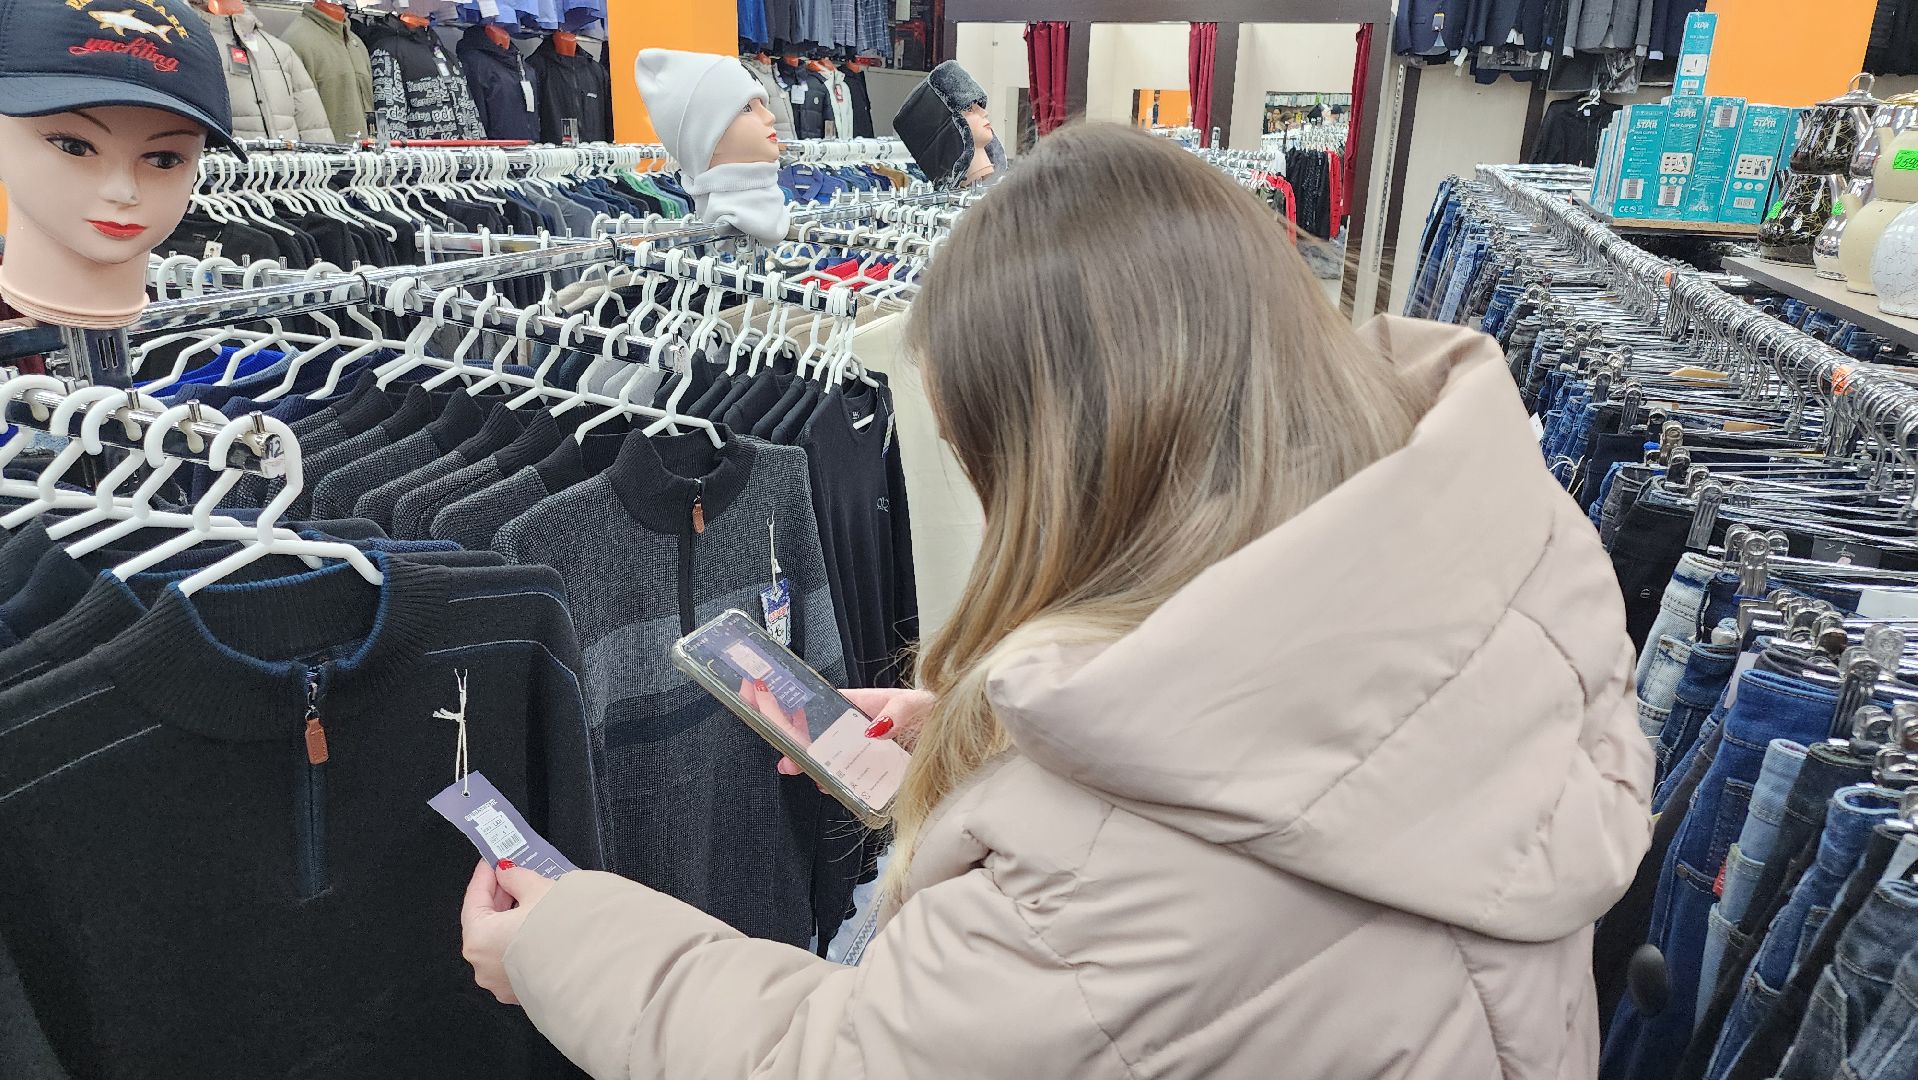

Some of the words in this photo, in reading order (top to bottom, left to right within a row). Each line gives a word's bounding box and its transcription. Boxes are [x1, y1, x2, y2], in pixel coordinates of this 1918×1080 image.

[68, 37, 180, 72] yachting
[1636, 121, 1657, 129] STAR
[1753, 119, 1776, 127] STAR
